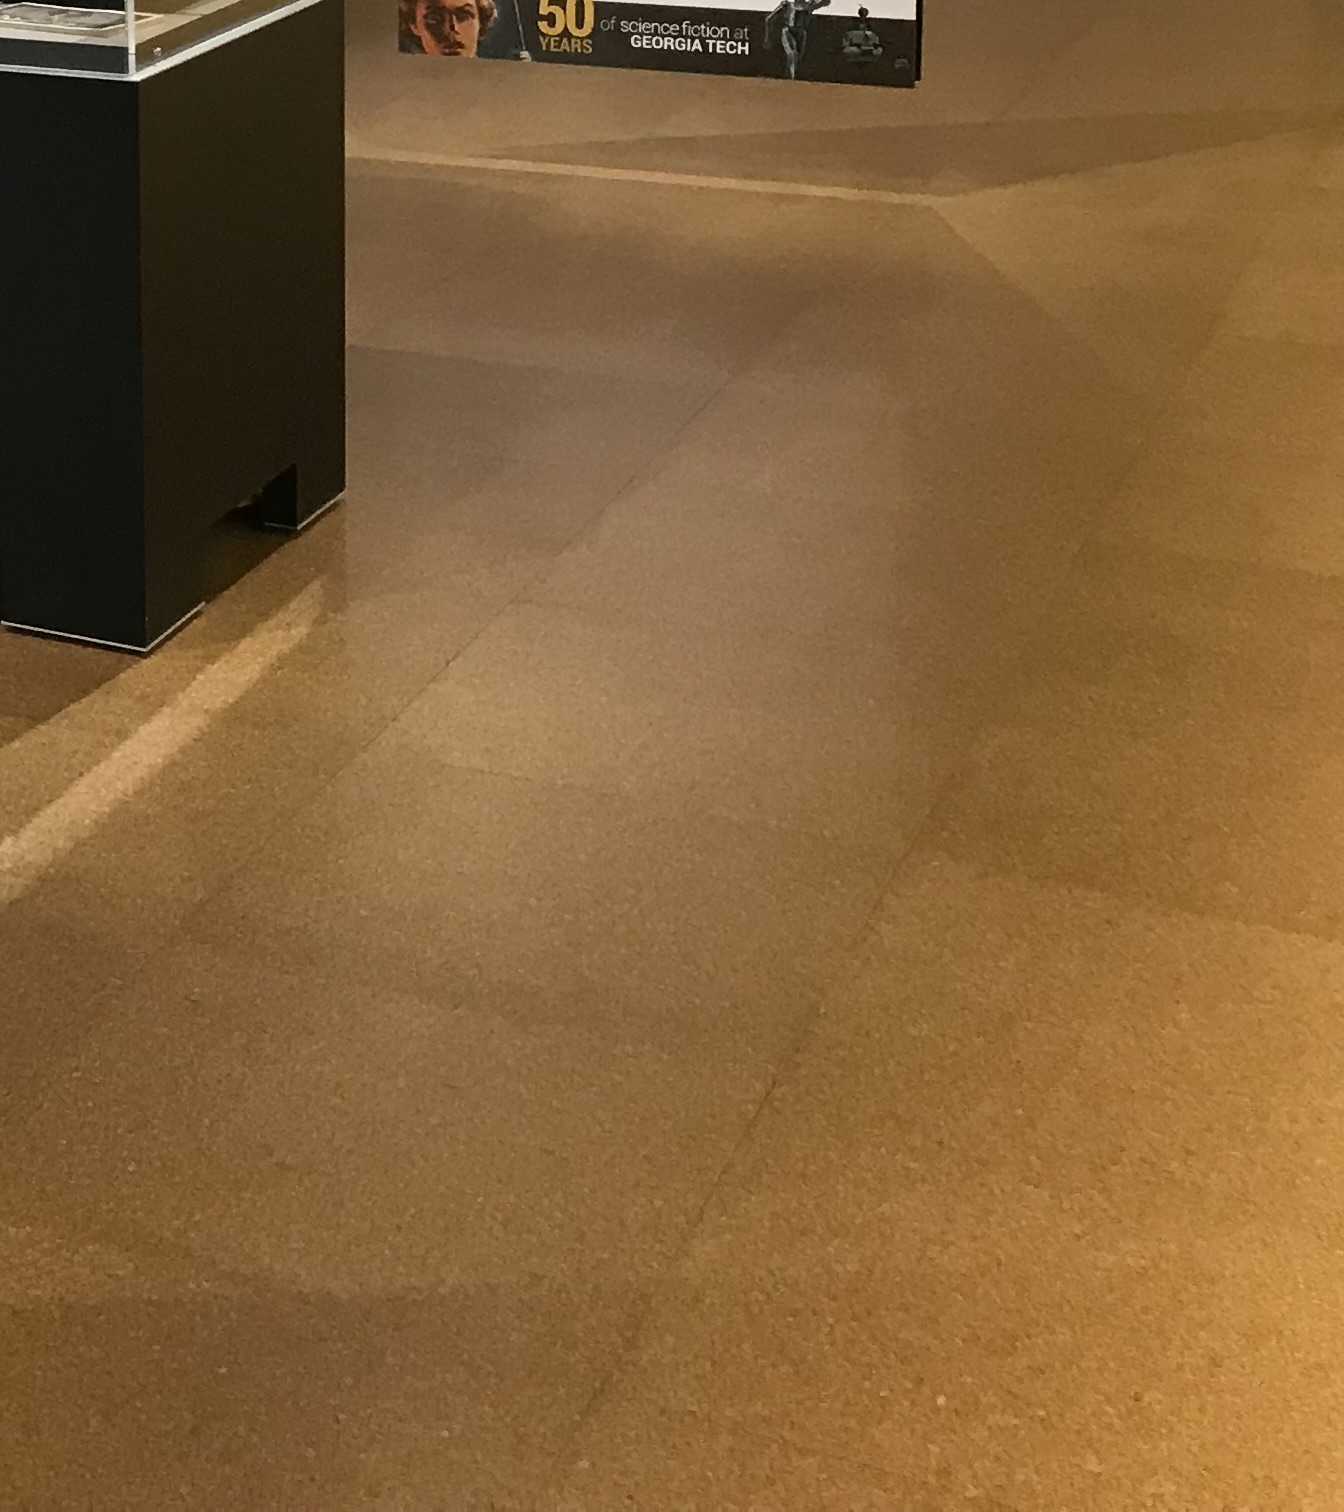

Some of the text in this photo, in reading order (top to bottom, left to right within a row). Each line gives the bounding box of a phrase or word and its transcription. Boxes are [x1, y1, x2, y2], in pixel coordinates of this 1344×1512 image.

[600, 16, 750, 41] of science fiction at
[538, 35, 593, 54] YEARS
[630, 35, 750, 55] GEORGIA TECH
